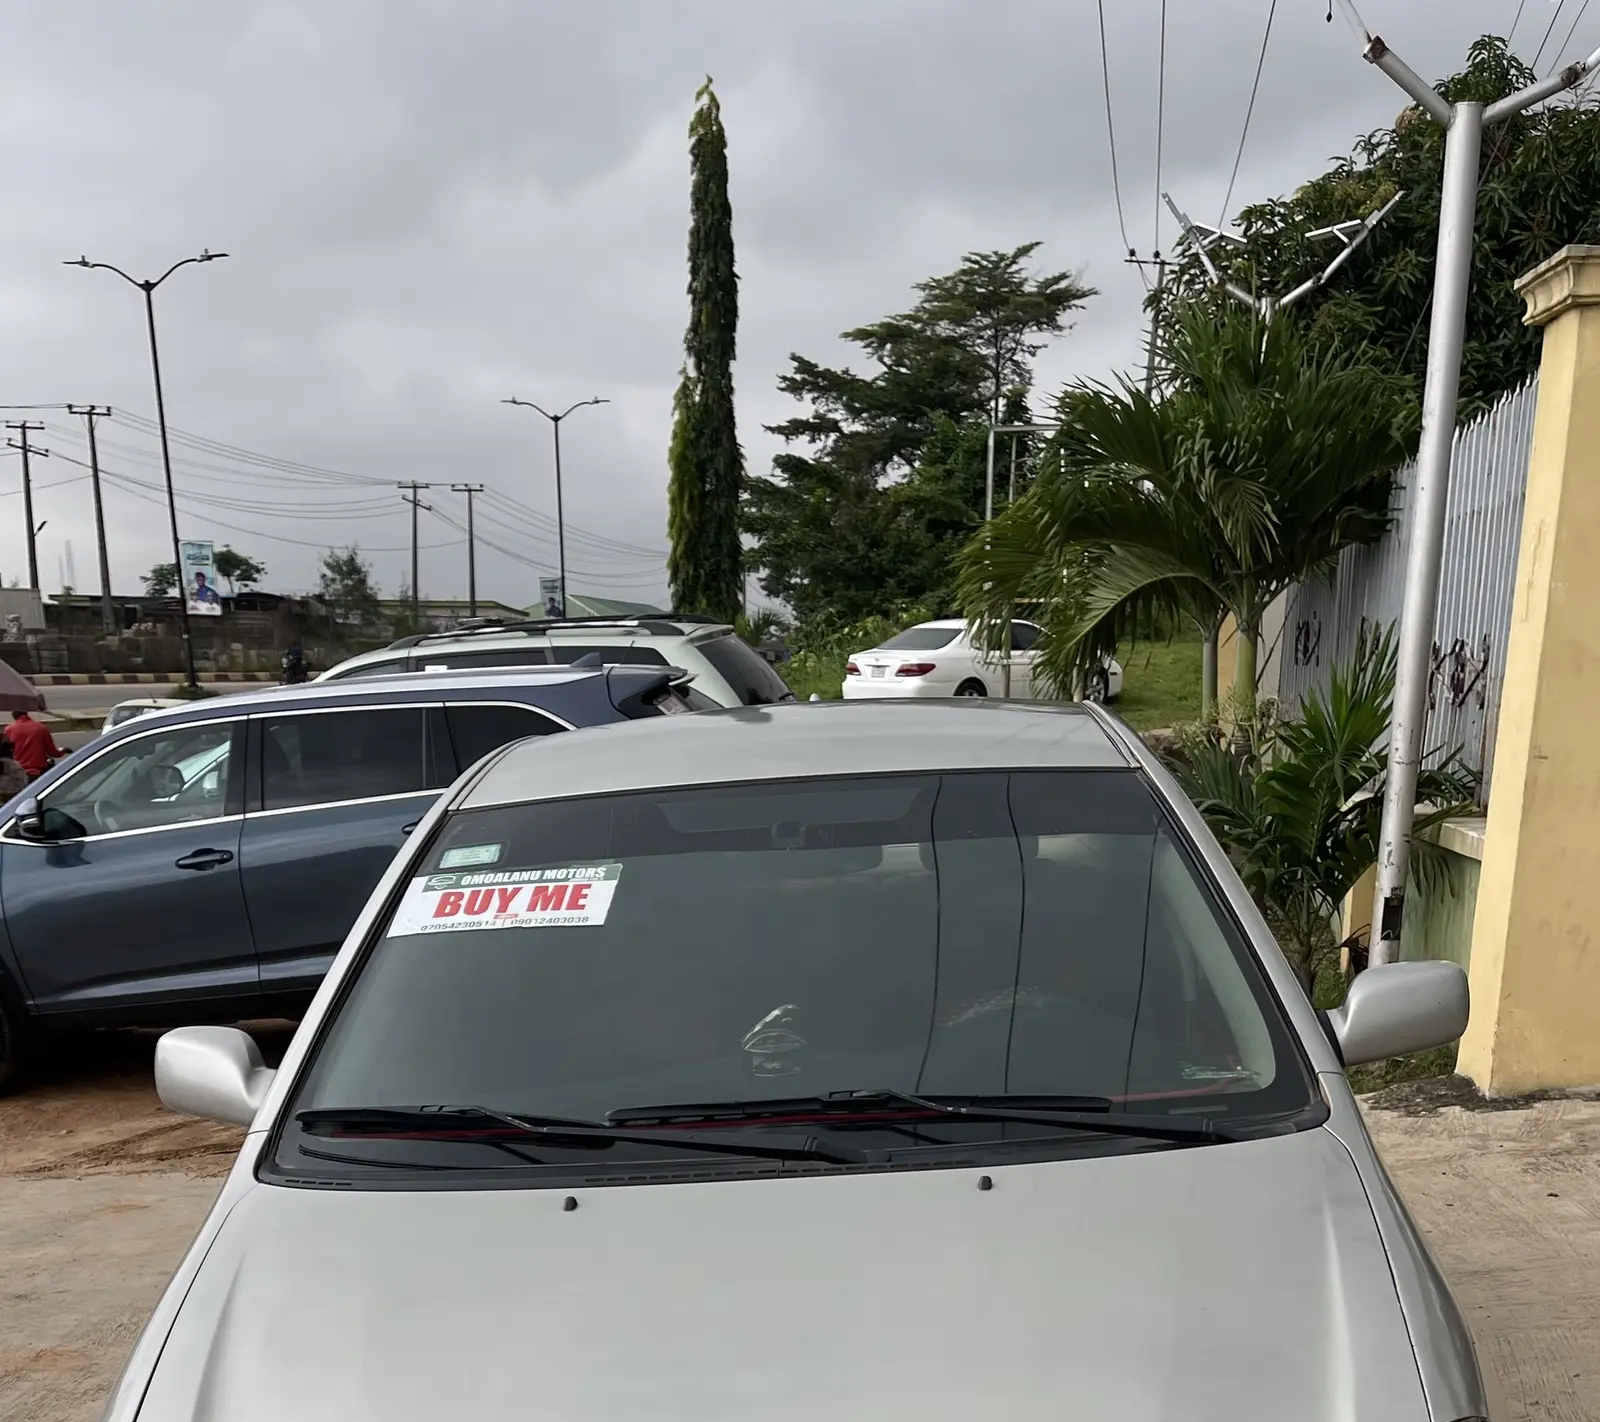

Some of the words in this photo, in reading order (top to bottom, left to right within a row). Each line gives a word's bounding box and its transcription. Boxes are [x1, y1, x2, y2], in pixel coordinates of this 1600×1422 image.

[461, 870, 541, 885] OMOALANU
[542, 867, 606, 880] MOTORS
[432, 887, 523, 918] BUY
[526, 884, 592, 912] ME
